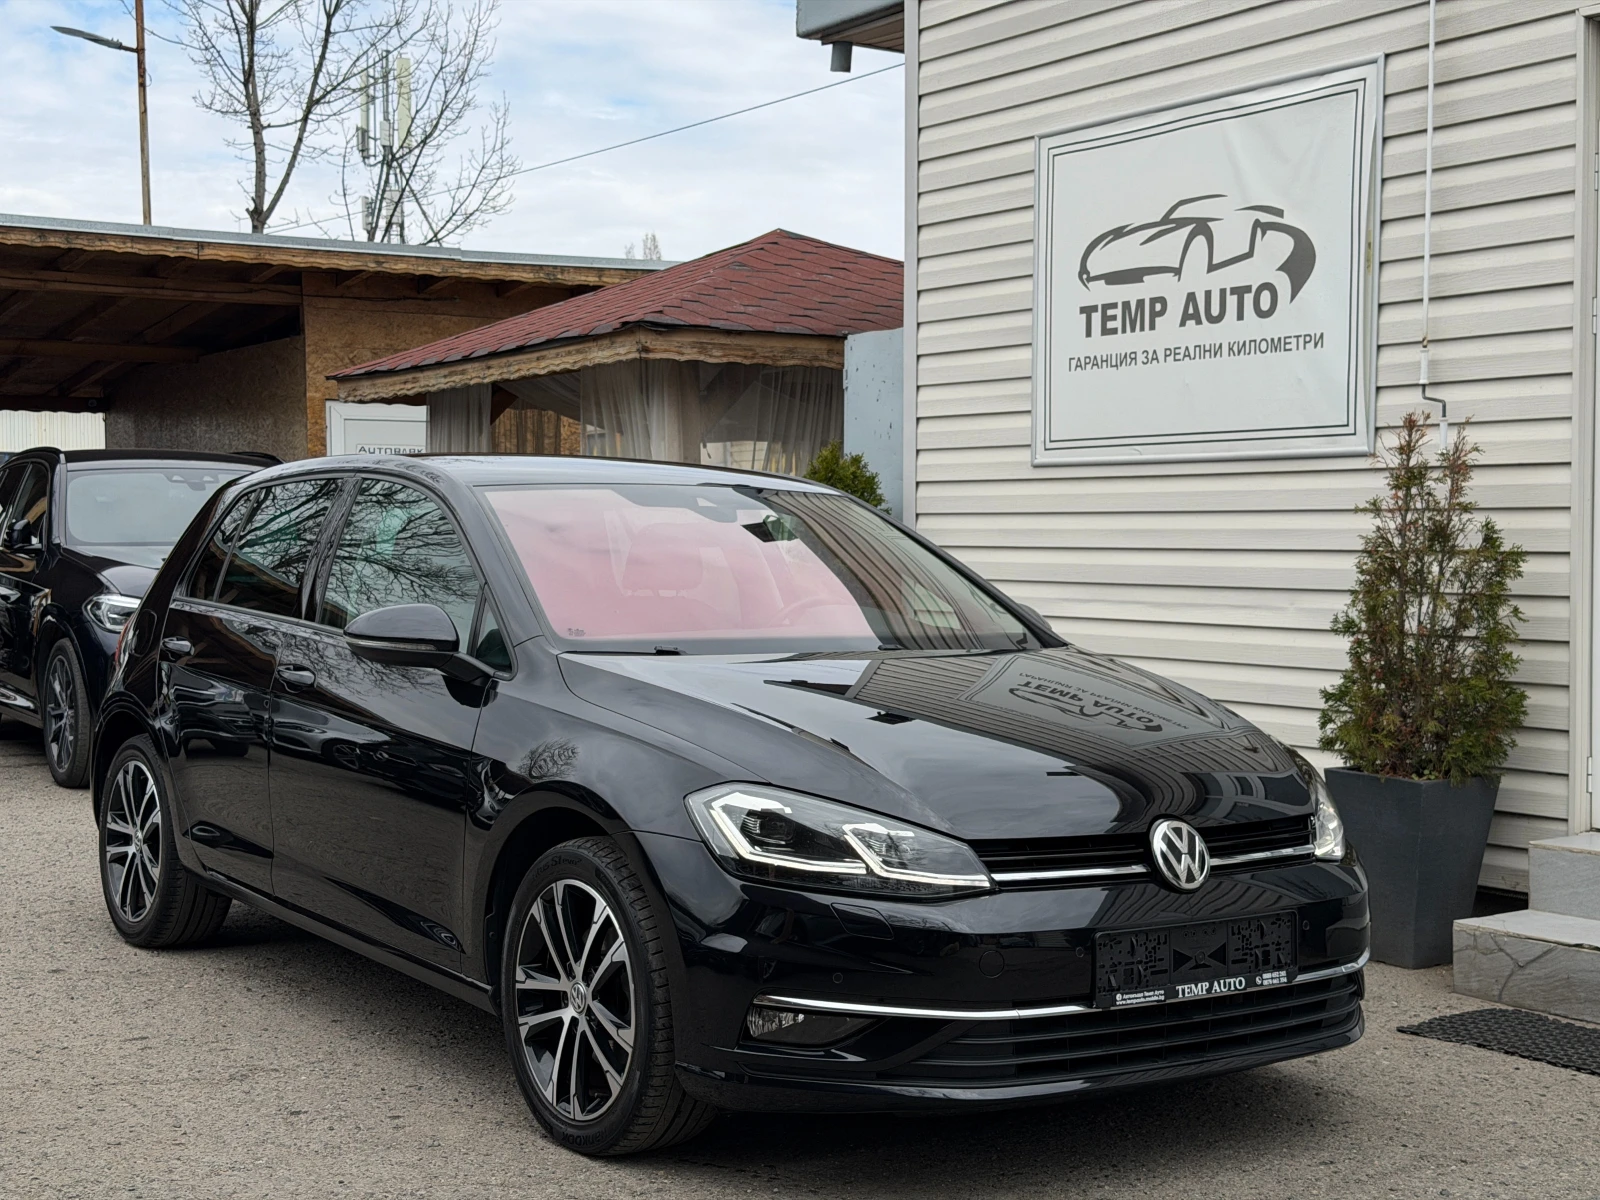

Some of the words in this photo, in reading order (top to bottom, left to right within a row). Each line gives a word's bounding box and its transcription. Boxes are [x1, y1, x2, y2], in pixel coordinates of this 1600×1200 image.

[1079, 295, 1168, 338] TEMP
[1178, 281, 1278, 328] AUTO
[1068, 350, 1138, 372] ГАРАНЦИЯ
[1141, 349, 1160, 366] ЗА
[1163, 340, 1224, 363] РЕАЛНИ
[1228, 332, 1325, 358] КИЛОМЕТРИ
[1176, 980, 1210, 998] TEMP
[1211, 977, 1246, 993] AUTO
